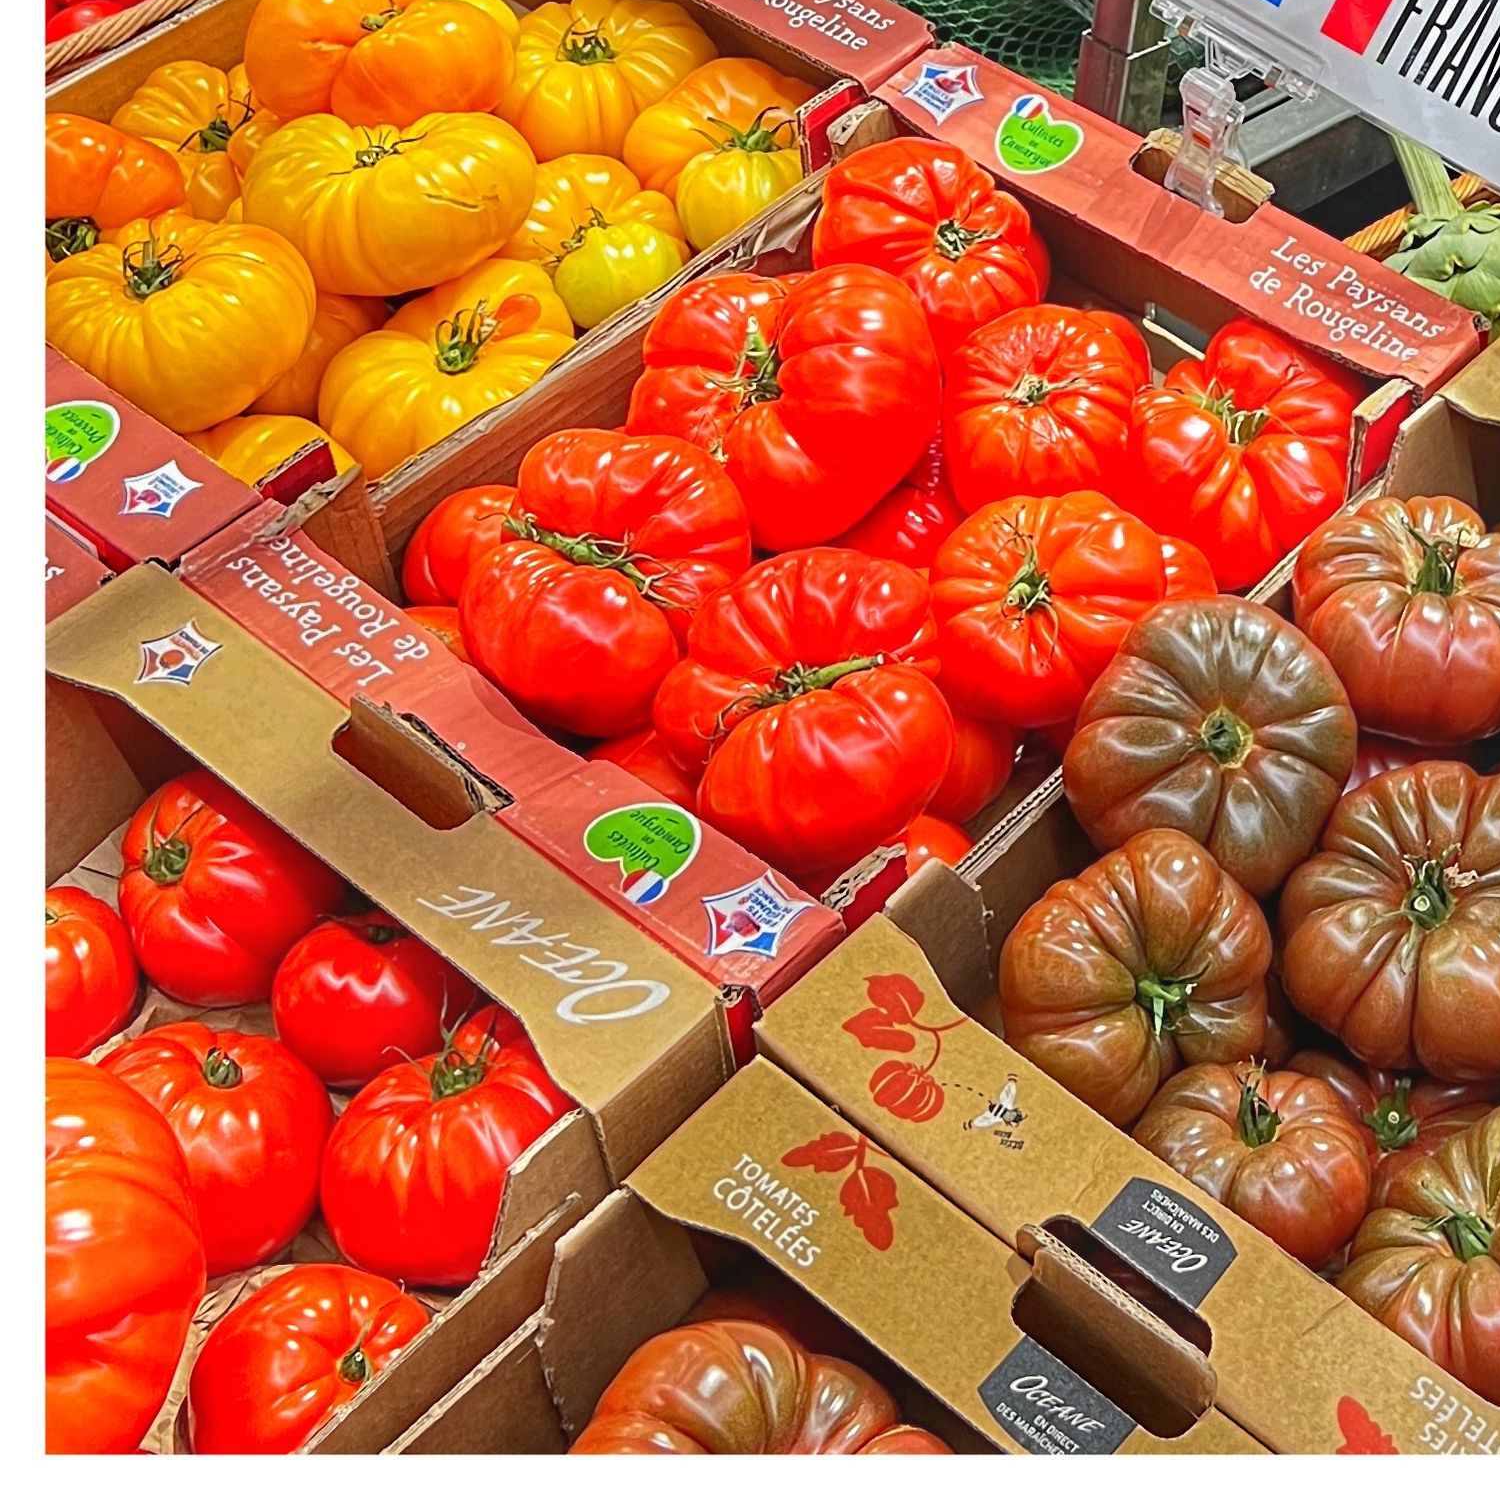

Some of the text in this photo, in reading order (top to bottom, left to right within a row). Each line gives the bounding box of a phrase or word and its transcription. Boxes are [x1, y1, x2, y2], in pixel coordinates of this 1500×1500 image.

[1002, 135, 1052, 167] Camargue
[1021, 120, 1064, 148] Cultivées
[1249, 264, 1420, 362] de Rougeline
[1270, 235, 1447, 339] Les Paysans
[225, 554, 343, 648] Paysans
[266, 535, 430, 662] de Rougeline
[335, 639, 394, 688] Les
[607, 830, 661, 870] Cultivées
[629, 811, 692, 855] Camargue
[416, 886, 670, 1025] OCEANE
[732, 1153, 821, 1229] TOMATES
[1142, 1199, 1185, 1234] EN DIRECT
[1150, 1188, 1220, 1244] DES MARAÎCHERS
[712, 1176, 822, 1270] CÔTELÉES
[1117, 1217, 1208, 1273] OCEANE
[995, 1401, 1017, 1420] DES
[1009, 1374, 1106, 1433] OCEANE
[1033, 1414, 1080, 1453] EN DIRECT
